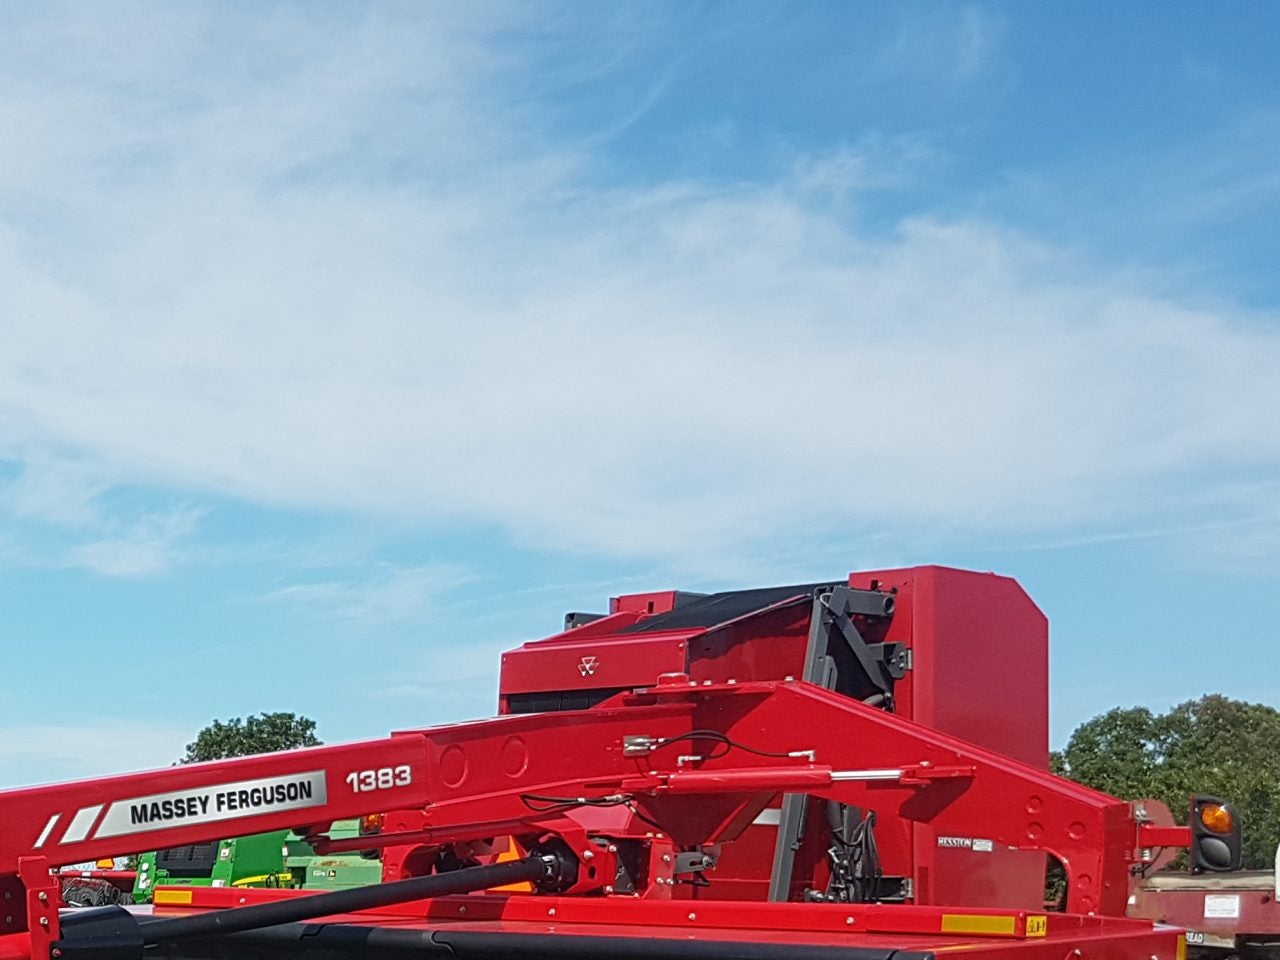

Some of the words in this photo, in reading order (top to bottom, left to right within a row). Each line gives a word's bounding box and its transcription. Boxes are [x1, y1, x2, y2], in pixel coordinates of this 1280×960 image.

[346, 765, 412, 793] 1383
[130, 794, 210, 825] MASSEY
[216, 780, 312, 812] FERGUSON
[938, 836, 972, 848] HESSTON
